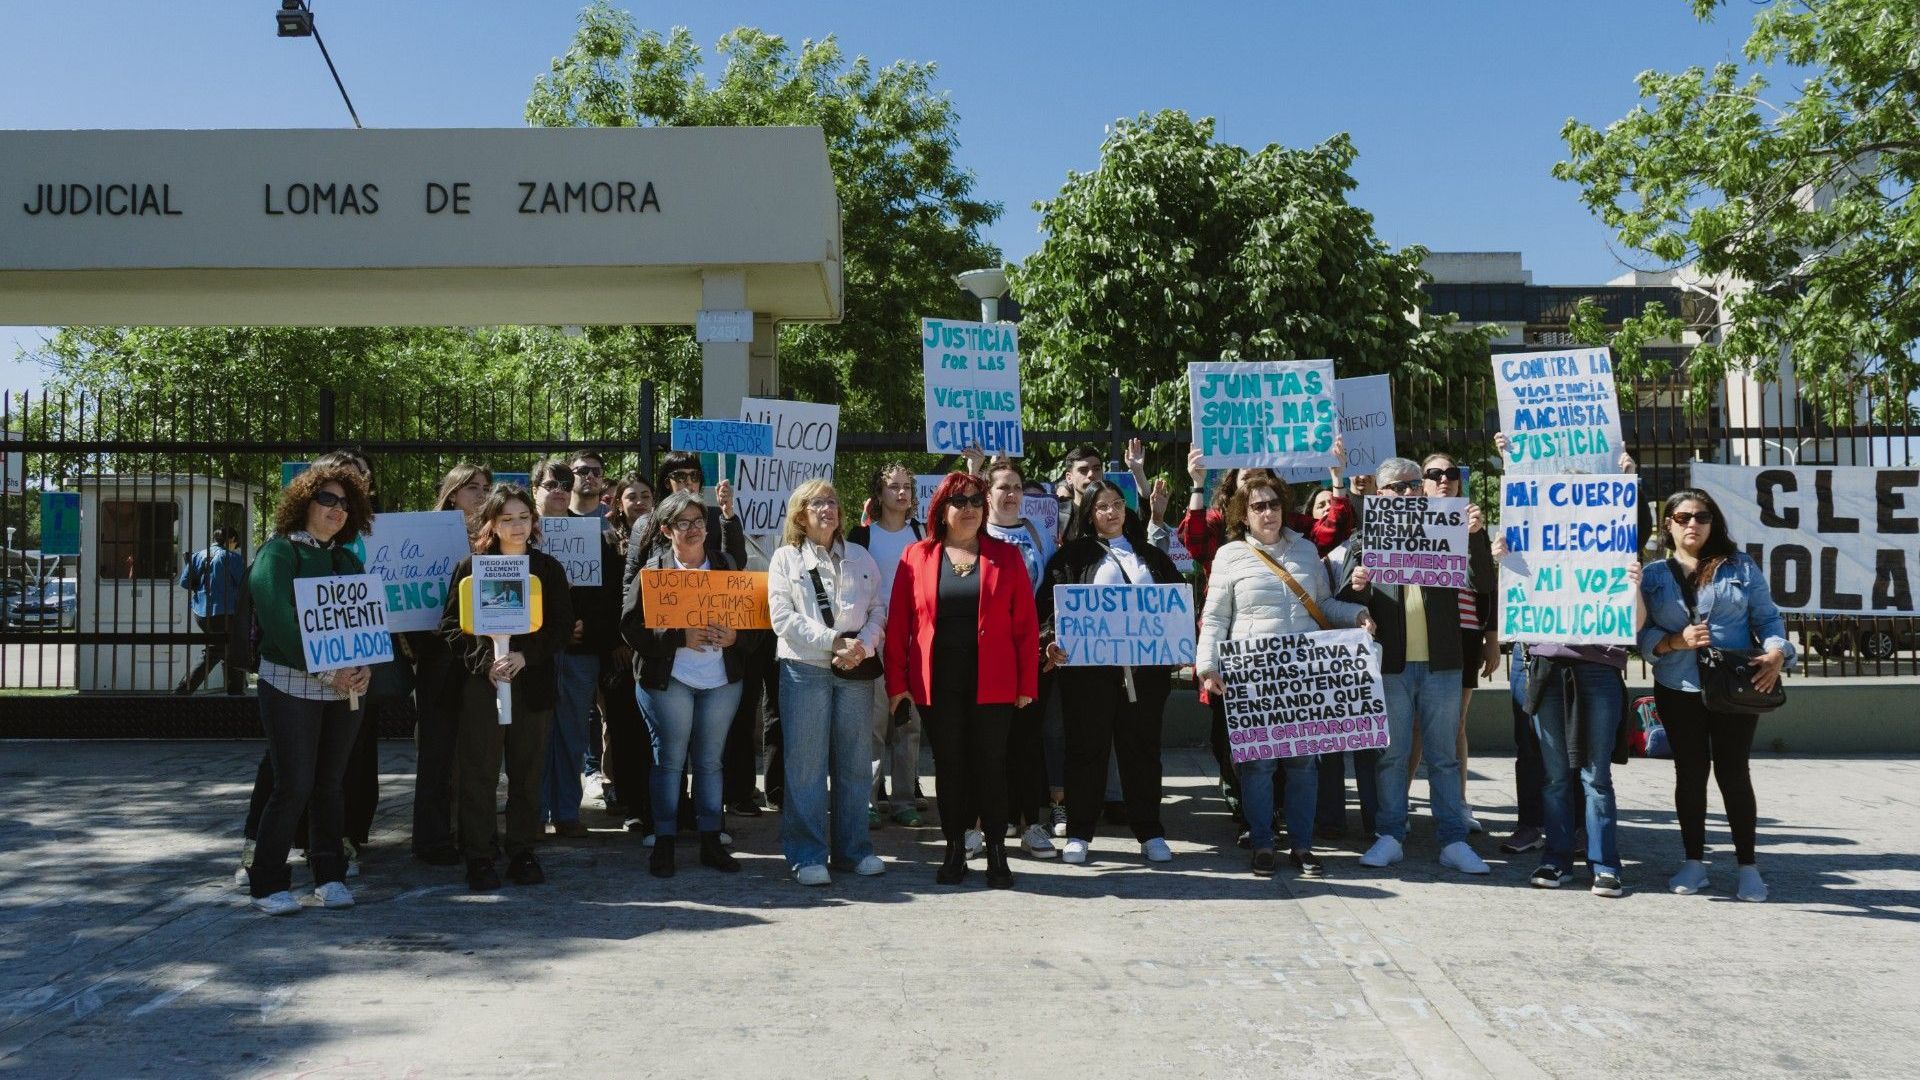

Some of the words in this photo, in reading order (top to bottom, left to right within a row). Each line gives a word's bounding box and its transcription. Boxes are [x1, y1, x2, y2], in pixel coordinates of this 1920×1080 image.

[24, 182, 183, 215] JUDICIAL
[264, 182, 379, 215] LOMAS
[425, 181, 471, 214] DE
[517, 181, 661, 214] ZAMORA
[941, 353, 968, 370] POR
[977, 355, 1006, 371] LAS
[1501, 356, 1579, 382] CONTRA
[1589, 353, 1612, 375] LA
[1199, 370, 1323, 400] JUNTAS
[967, 409, 986, 420] DE
[1200, 400, 1275, 426] SOMOS
[1282, 397, 1335, 424] MÁS
[679, 420, 714, 432] DIEGO
[719, 421, 767, 437] CLEMENTI
[775, 413, 833, 452] LOCO
[1201, 424, 1334, 456] FUERTES
[920, 484, 937, 499] JUS
[1367, 497, 1429, 511] VOCES
[1549, 481, 1636, 509] CUERPO
[1755, 469, 1920, 534] CLE
[1364, 523, 1427, 539] MISMA
[1365, 510, 1465, 527] DISTINTAS,
[373, 545, 391, 564] a
[400, 538, 425, 560] la
[1363, 536, 1451, 552] HISTORIA
[424, 556, 454, 577] del
[560, 559, 600, 584] ADOR
[1363, 552, 1467, 571] CLEMENTI
[649, 570, 712, 591] JUSTICIA
[727, 575, 754, 590] PARA
[1367, 569, 1467, 587] VIOLADOR
[1574, 567, 1629, 596] VOZ
[1746, 542, 1920, 612] OLA
[659, 591, 678, 606] LAS
[1064, 586, 1187, 614] JUSTICIA
[655, 613, 669, 627] DE
[686, 610, 757, 628] CLEMENTI
[1060, 615, 1111, 637] PARA
[1125, 615, 1165, 637] LAS
[1059, 637, 1195, 665] VICTIMAS
[1219, 642, 1241, 657] MI
[1245, 633, 1316, 654] LUCHA,
[1221, 651, 1292, 672] ESPERO
[1296, 643, 1351, 662] SIRVA
[1356, 643, 1371, 656] A
[1223, 664, 1305, 686] MUCHAS,
[1307, 657, 1367, 677] LLORO
[1225, 685, 1249, 700] DE
[1255, 670, 1375, 697] IMPOTENCIA
[1226, 692, 1326, 715] PENSANDO
[1333, 686, 1373, 704] QUE
[1227, 713, 1265, 730] SON
[1268, 703, 1346, 726] MUCHAS
[1348, 699, 1384, 716] LAS
[1229, 727, 1269, 745] QUE
[1271, 716, 1372, 740] GRITARON
[1372, 715, 1387, 730] Y
[1231, 741, 1292, 763] NADIE
[1295, 731, 1389, 757] ESCUCHA
